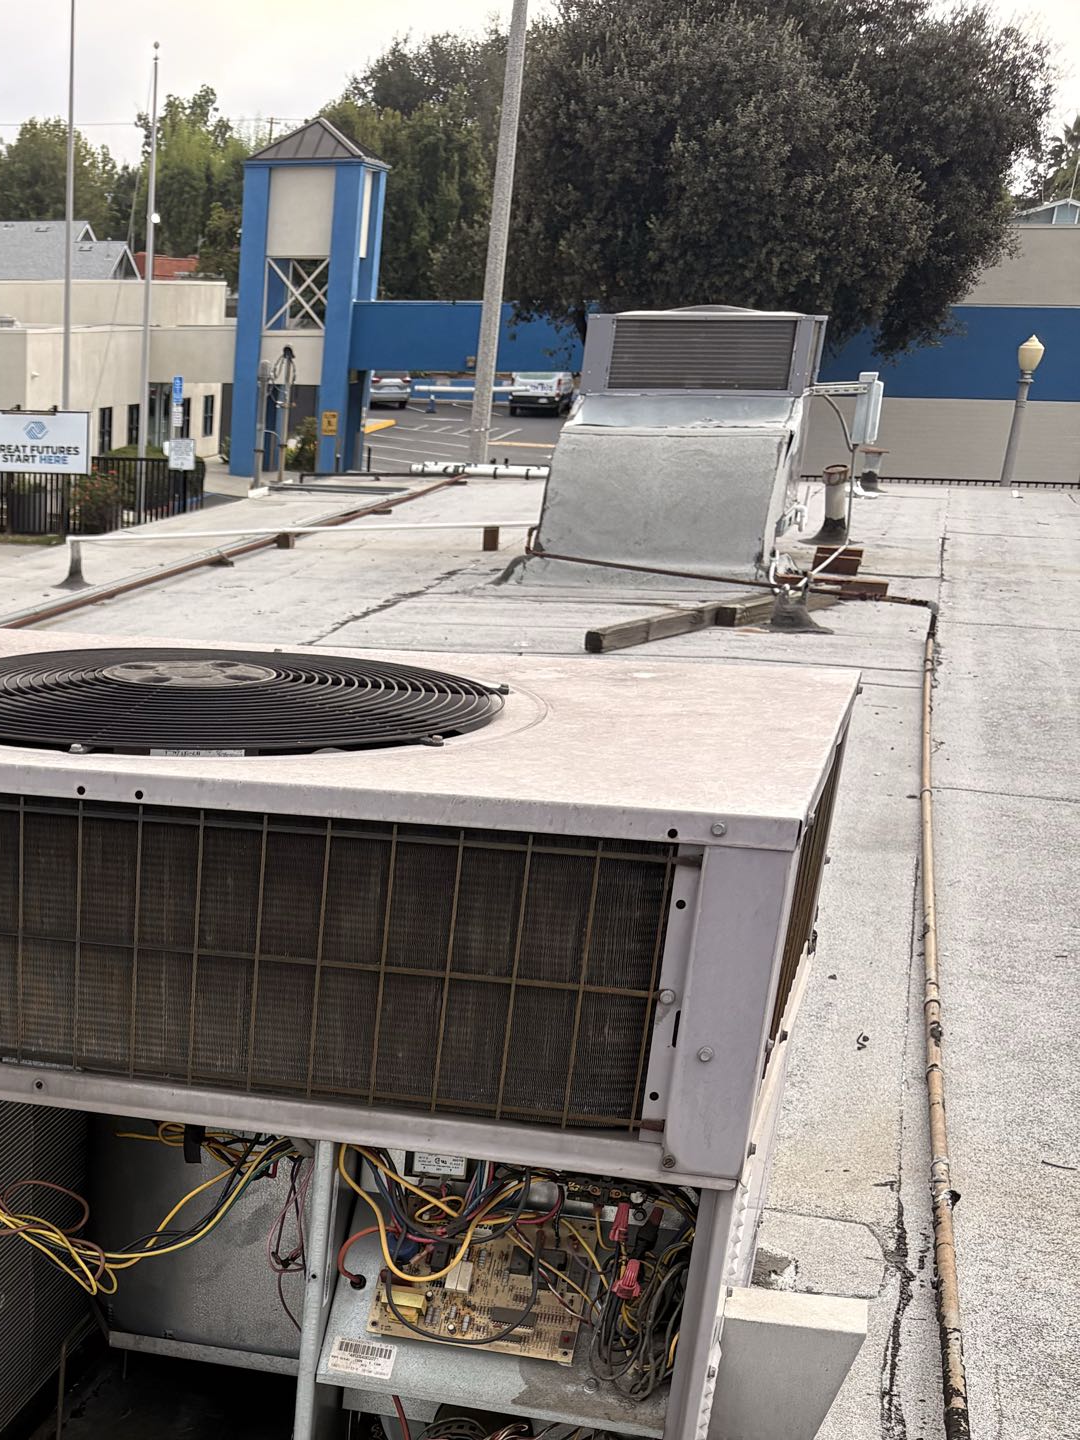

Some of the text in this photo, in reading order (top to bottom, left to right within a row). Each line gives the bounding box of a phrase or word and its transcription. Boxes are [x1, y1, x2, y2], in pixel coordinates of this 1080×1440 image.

[30, 445, 80, 455] FUTURES
[2, 454, 68, 464] START HERE
